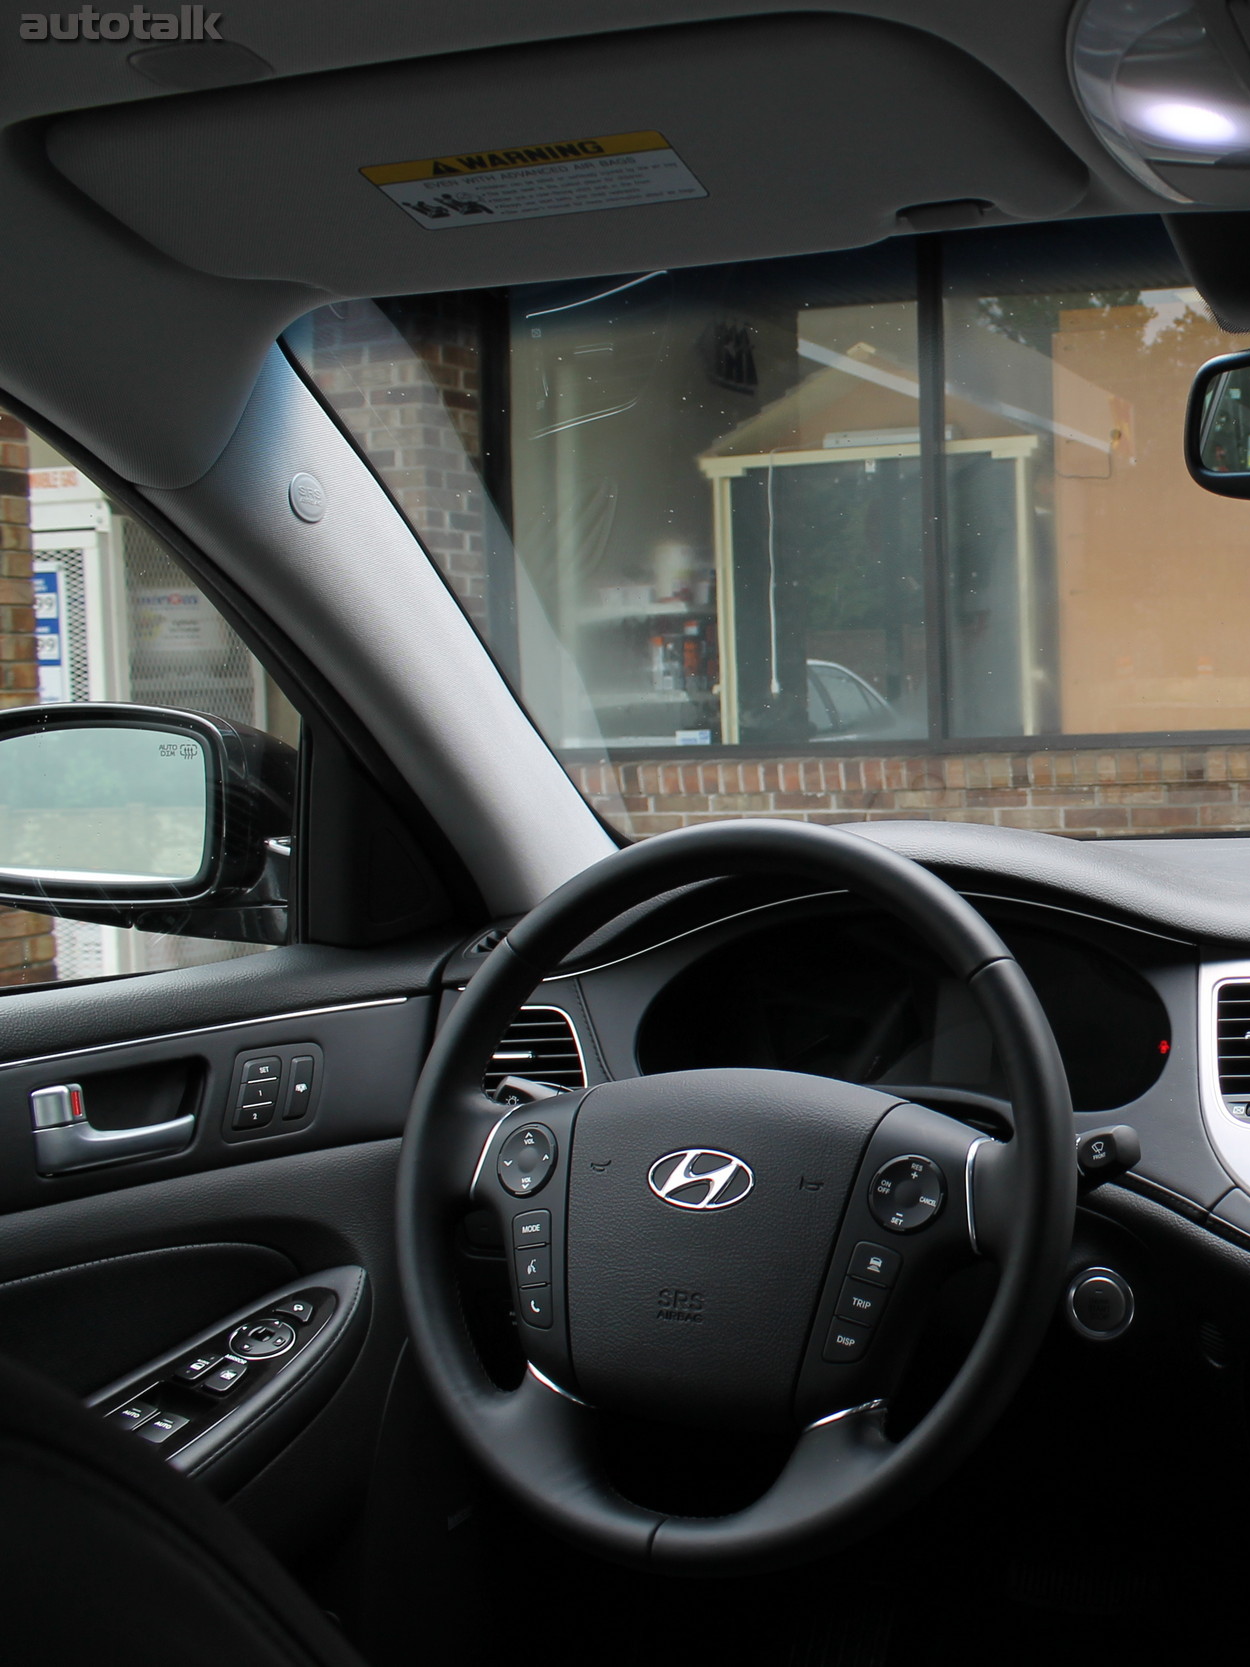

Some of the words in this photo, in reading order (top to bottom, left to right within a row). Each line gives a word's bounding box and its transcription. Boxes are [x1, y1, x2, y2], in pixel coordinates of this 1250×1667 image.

[457, 139, 605, 170] WARNING
[423, 179, 459, 189] EVEN
[462, 174, 496, 185] WITH
[500, 165, 569, 181] ADVANCED
[573, 161, 596, 171] AIR
[599, 155, 637, 167] BAGS
[252, 1112, 258, 1120] 2
[880, 1179, 892, 1188] ON
[877, 1185, 891, 1195] OFF
[918, 1195, 937, 1208] CANCEL
[890, 1216, 904, 1226] SET
[521, 1224, 541, 1234] MODE
[658, 1288, 705, 1310] SRS
[852, 1296, 872, 1309] TRIP
[656, 1309, 705, 1324] AIRBAG
[836, 1334, 856, 1347] DISP
[121, 1408, 141, 1420] AUTO
[153, 1419, 173, 1431] AUTO
